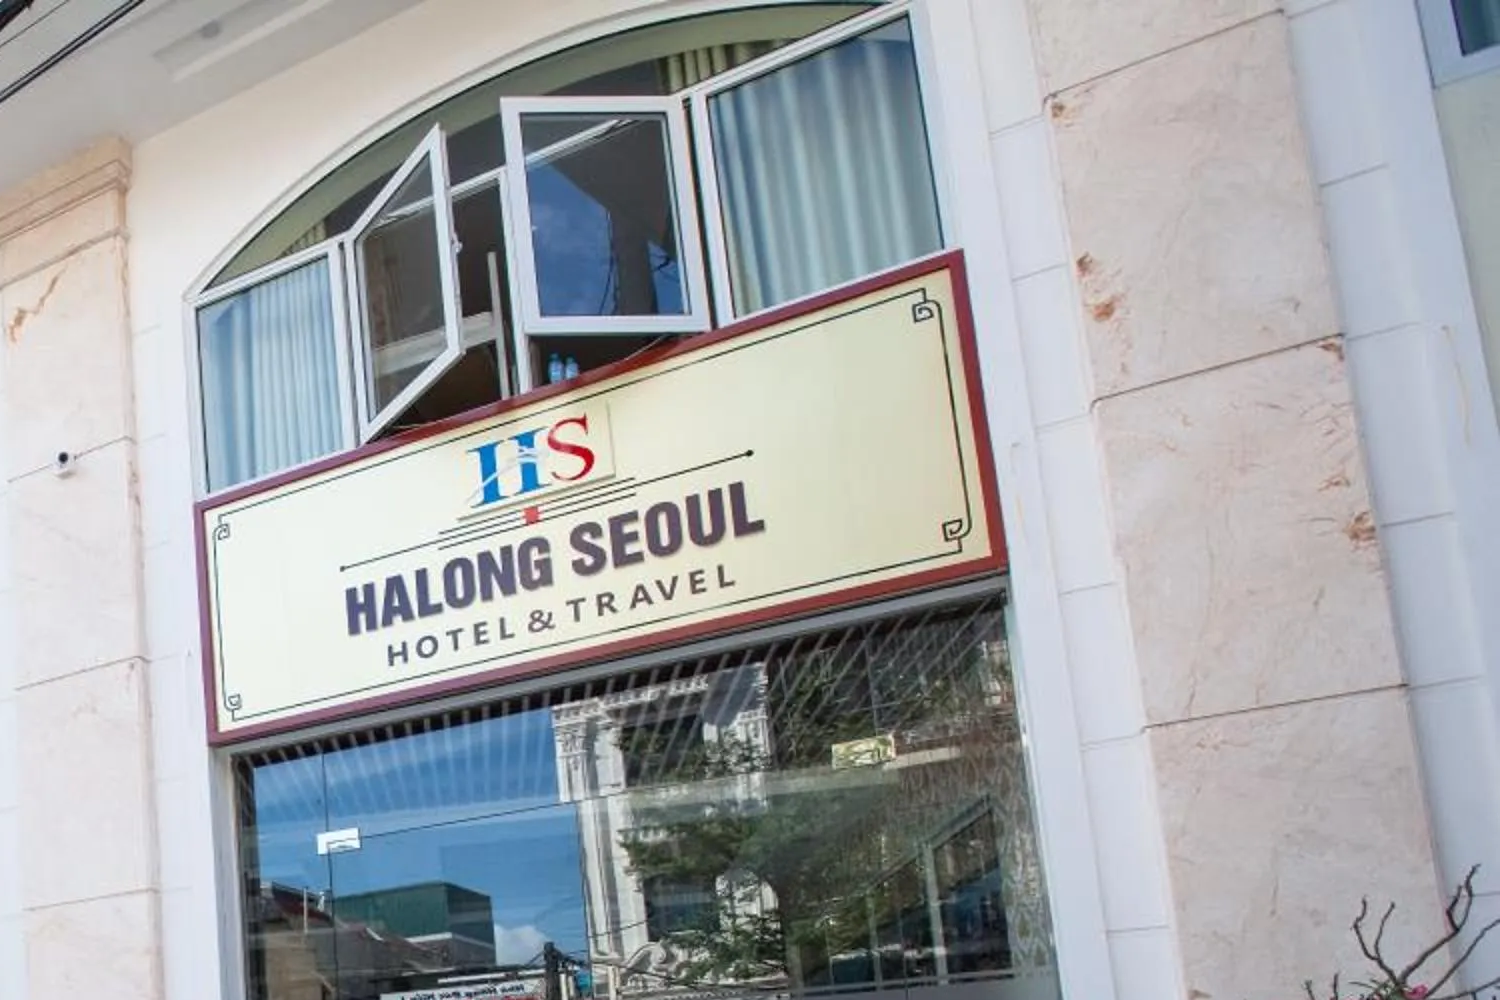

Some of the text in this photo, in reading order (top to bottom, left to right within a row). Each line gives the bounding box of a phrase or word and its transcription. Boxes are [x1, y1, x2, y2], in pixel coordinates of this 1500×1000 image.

[344, 481, 765, 636] HALONG SEOUL
[387, 616, 515, 667] HOTEL
[566, 565, 736, 622] TRAVEL
